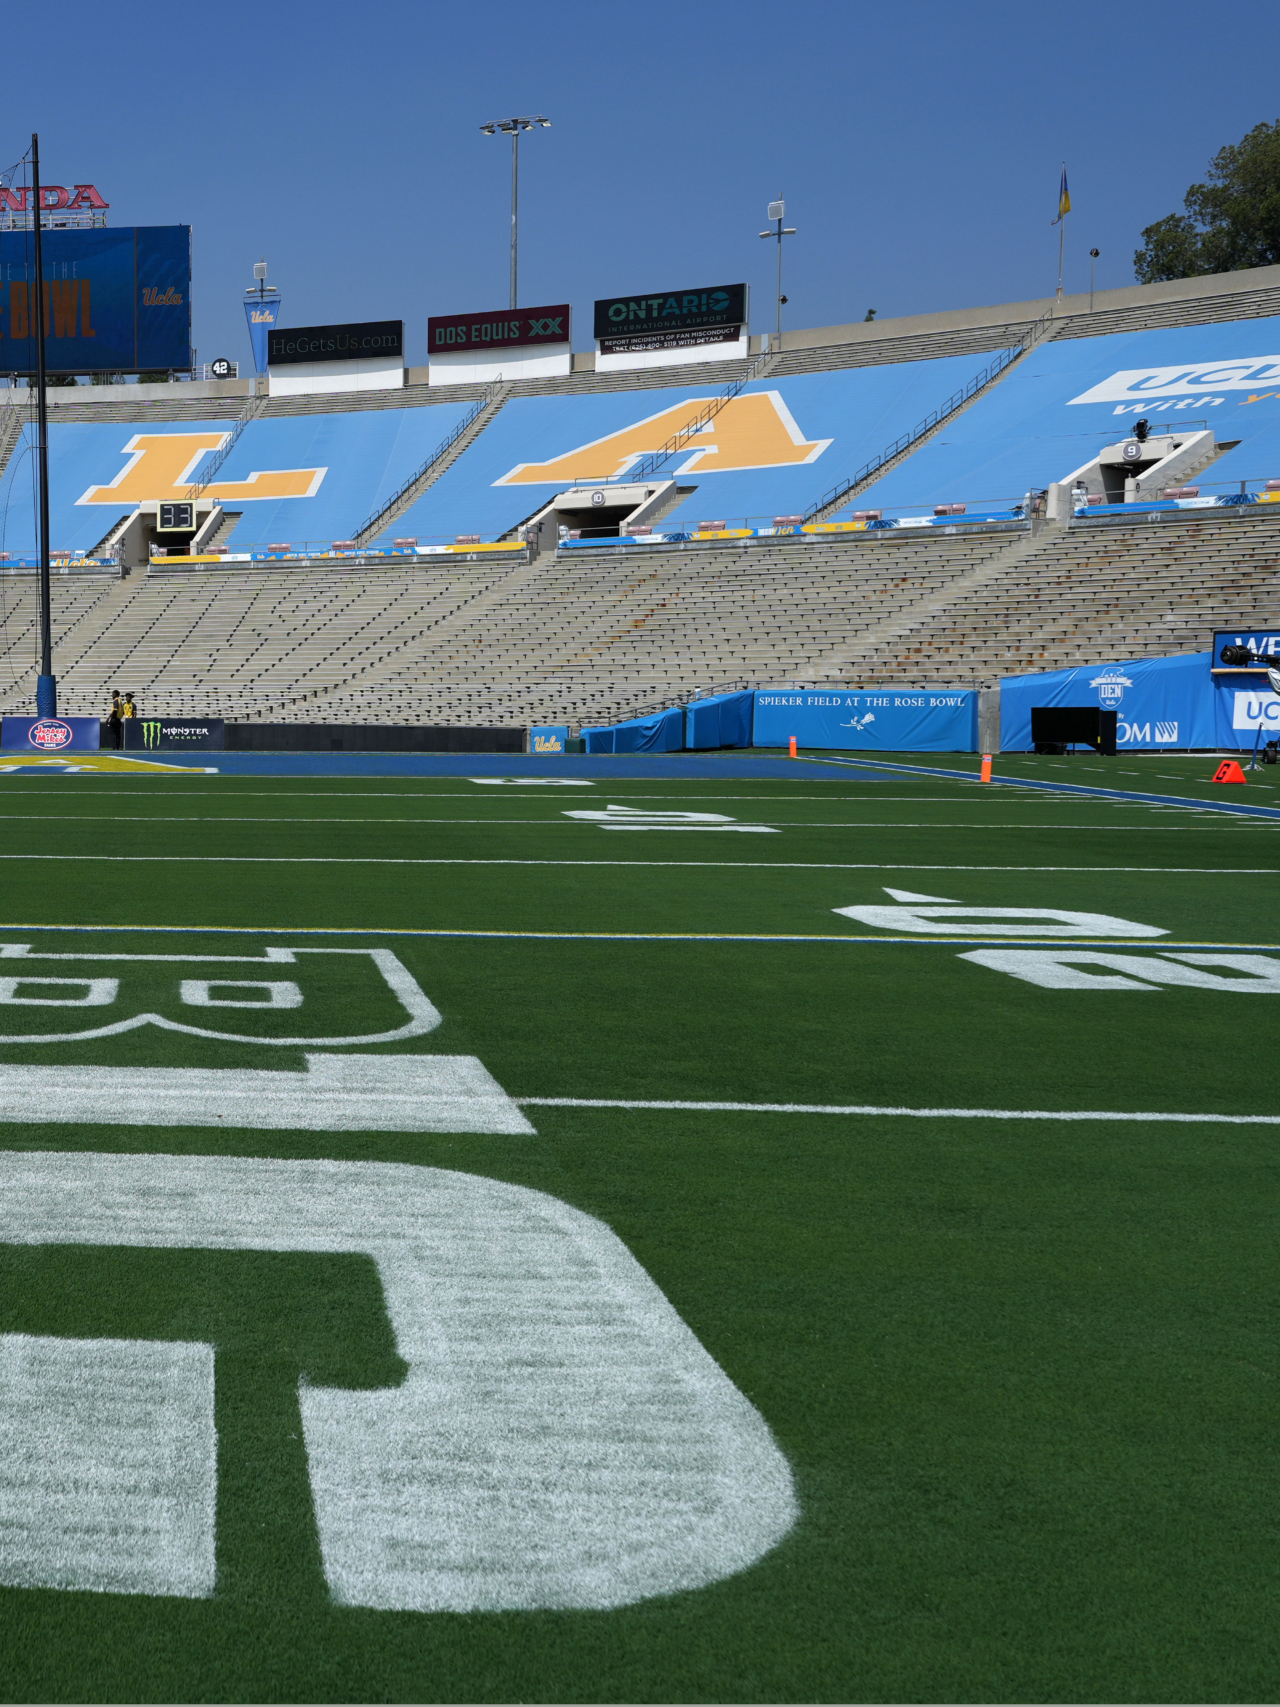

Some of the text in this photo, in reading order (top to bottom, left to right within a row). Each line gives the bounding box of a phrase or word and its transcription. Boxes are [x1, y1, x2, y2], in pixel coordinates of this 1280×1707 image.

[52, 261, 78, 279] THE
[142, 286, 184, 306] Ucla
[10, 278, 96, 339] BOWL
[608, 291, 730, 322] ONTARIO
[250, 310, 275, 324] Ucla
[608, 314, 728, 333] INTERNATIONAL AIRPORT
[435, 316, 564, 345] DOS EQUIS XX
[604, 338, 630, 346] REPORT
[630, 335, 665, 344] INCIDENTS
[691, 327, 735, 338] MISCONDUCT
[272, 333, 399, 355] HeGetsUs.com
[677, 337, 696, 345] WITH
[213, 362, 228, 374] 42
[1237, 392, 1280, 406] y
[1128, 446, 1136, 456] 9
[593, 493, 602, 502] 10
[163, 504, 191, 528] 33
[1101, 684, 1122, 698] DEN
[758, 697, 965, 707] SPIEKER FIELD AT THE ROSE BOWL
[162, 726, 209, 736] MONSTER
[534, 733, 563, 753] Ucla
[1215, 762, 1231, 781] G
